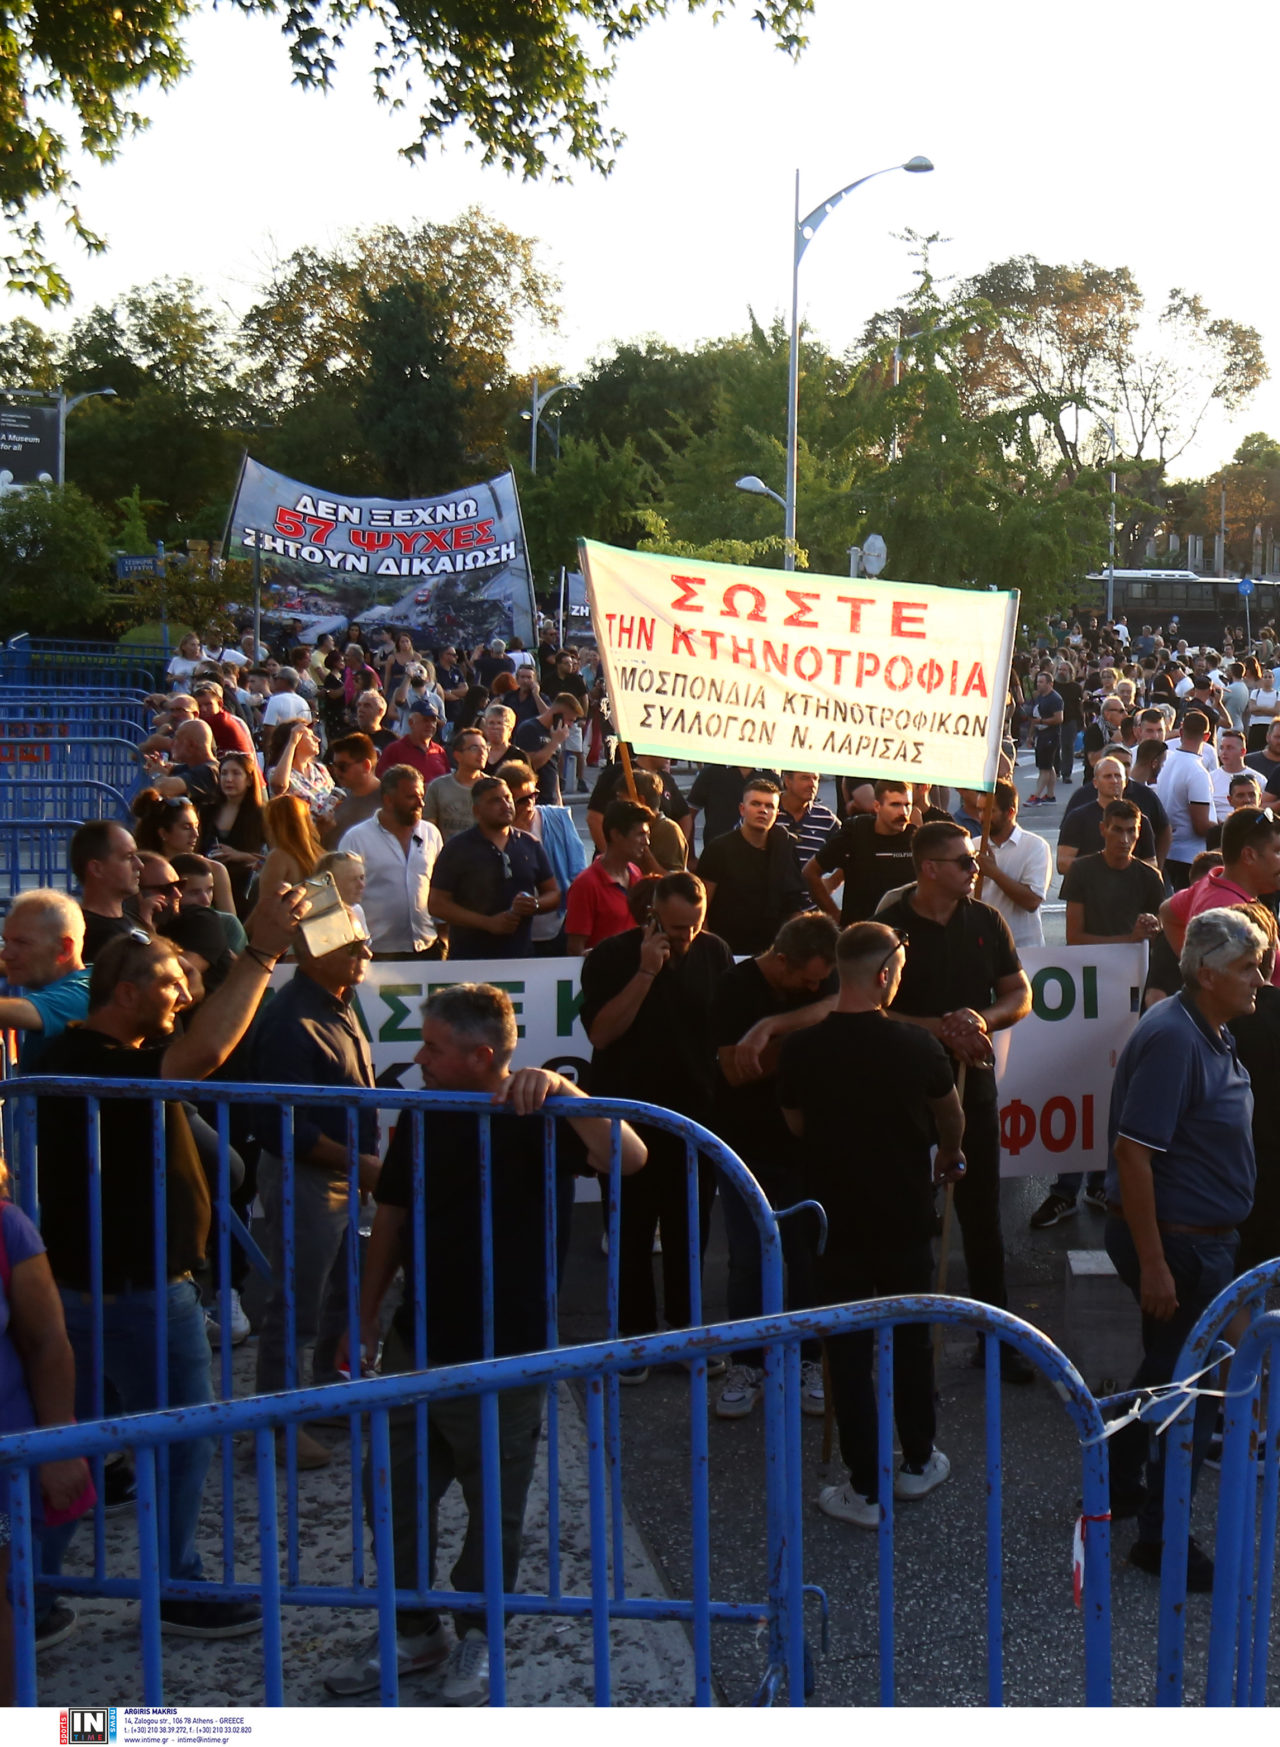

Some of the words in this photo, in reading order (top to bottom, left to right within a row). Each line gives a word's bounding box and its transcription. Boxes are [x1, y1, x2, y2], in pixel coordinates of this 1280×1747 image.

[0, 443, 11, 451] for
[12, 444, 23, 452] all
[8, 434, 41, 444] Museum
[274, 507, 336, 546] 57
[350, 519, 496, 555] ΨΥΧΕΣ
[295, 494, 360, 524] ΔΕΝ
[371, 498, 478, 527] ΞΕΧΝΩ
[242, 528, 368, 574] ΖΗΤΟΥΝ
[377, 540, 517, 577] ΔΙΚΑΙΩΣΗ
[670, 574, 930, 640] ΣΩΣΤΕ
[604, 613, 656, 653] ΤΗΝ
[672, 624, 988, 698] ΚΤΗΝΟΤΡΟΦΙΑ
[640, 703, 776, 745] ΣΥΛΛΟΓΩΝ
[790, 727, 813, 750] Ν.
[822, 731, 925, 765] ΛΑΡΙΣΑΣ
[782, 691, 989, 739] ΚΤΗΝΟΤΡΟΦΙΚΩΝ
